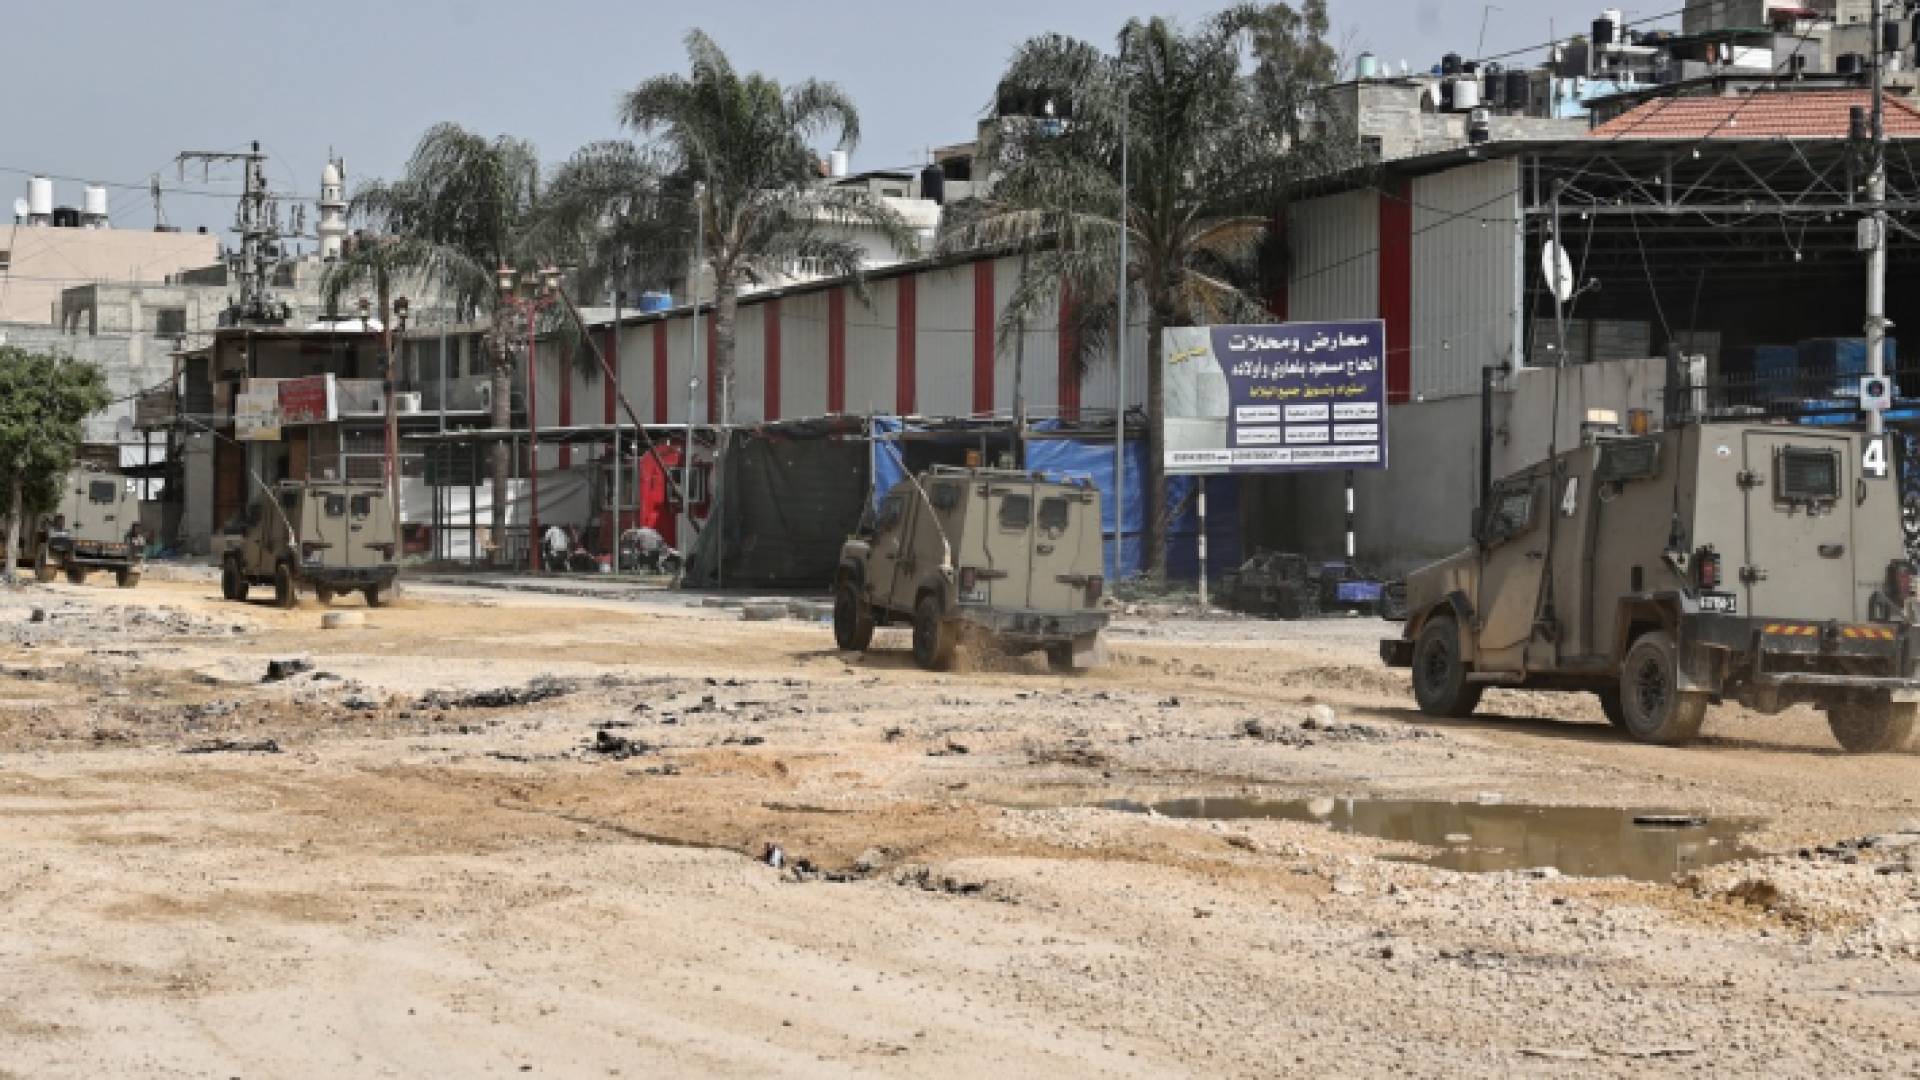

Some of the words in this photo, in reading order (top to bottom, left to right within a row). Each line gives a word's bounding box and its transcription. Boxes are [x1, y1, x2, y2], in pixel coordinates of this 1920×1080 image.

[1228, 334, 1300, 353] ومحلات
[1304, 331, 1370, 353] معارض
[1309, 360, 1345, 378] مسعود
[1347, 355, 1378, 378] الحاج
[1862, 439, 1888, 477] 4
[1561, 477, 1578, 516] 4
